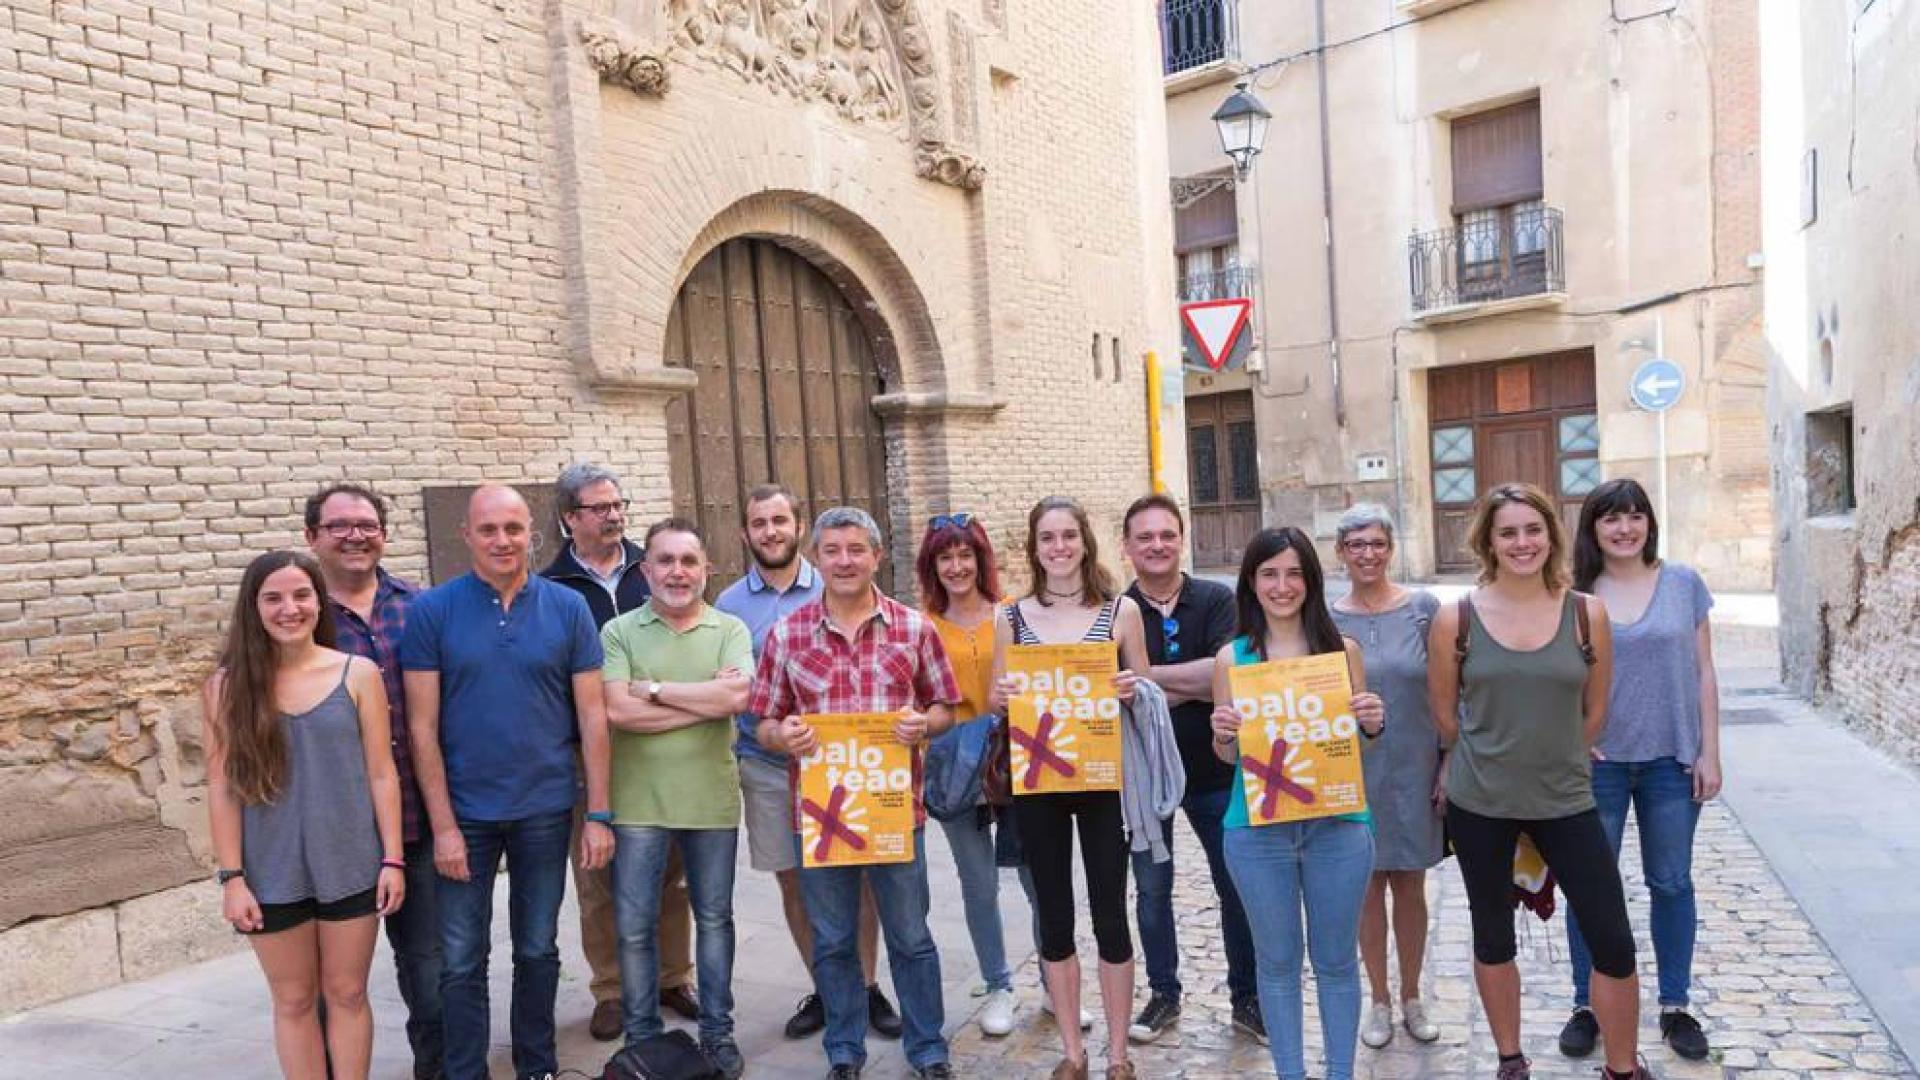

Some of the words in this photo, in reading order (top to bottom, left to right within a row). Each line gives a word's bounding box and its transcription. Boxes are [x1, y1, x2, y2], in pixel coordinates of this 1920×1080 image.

[1034, 694, 1119, 719] teao
[1233, 687, 1323, 720] palo
[1264, 715, 1357, 745] teao
[826, 765, 912, 792] teao
